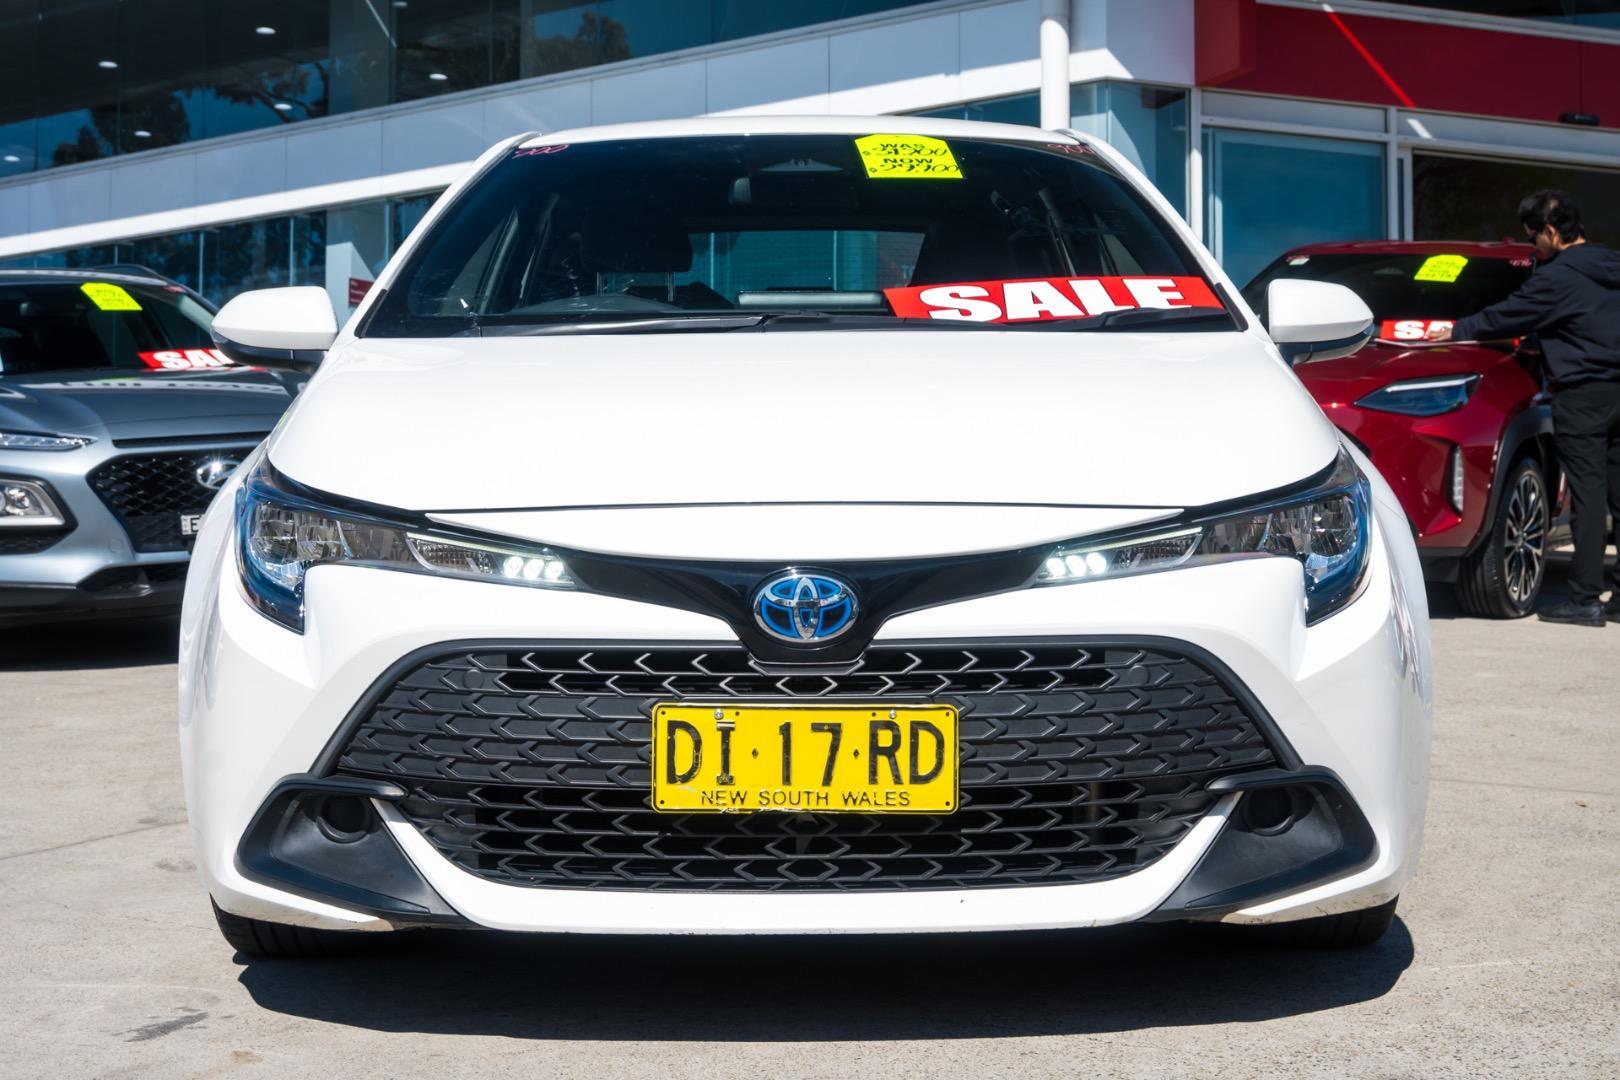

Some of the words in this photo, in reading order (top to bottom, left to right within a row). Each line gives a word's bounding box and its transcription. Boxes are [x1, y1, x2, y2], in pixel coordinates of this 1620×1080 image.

[919, 279, 1193, 322] SALE
[701, 790, 747, 806] NEW
[758, 790, 829, 806] SOUTH
[841, 790, 911, 806] WALES
